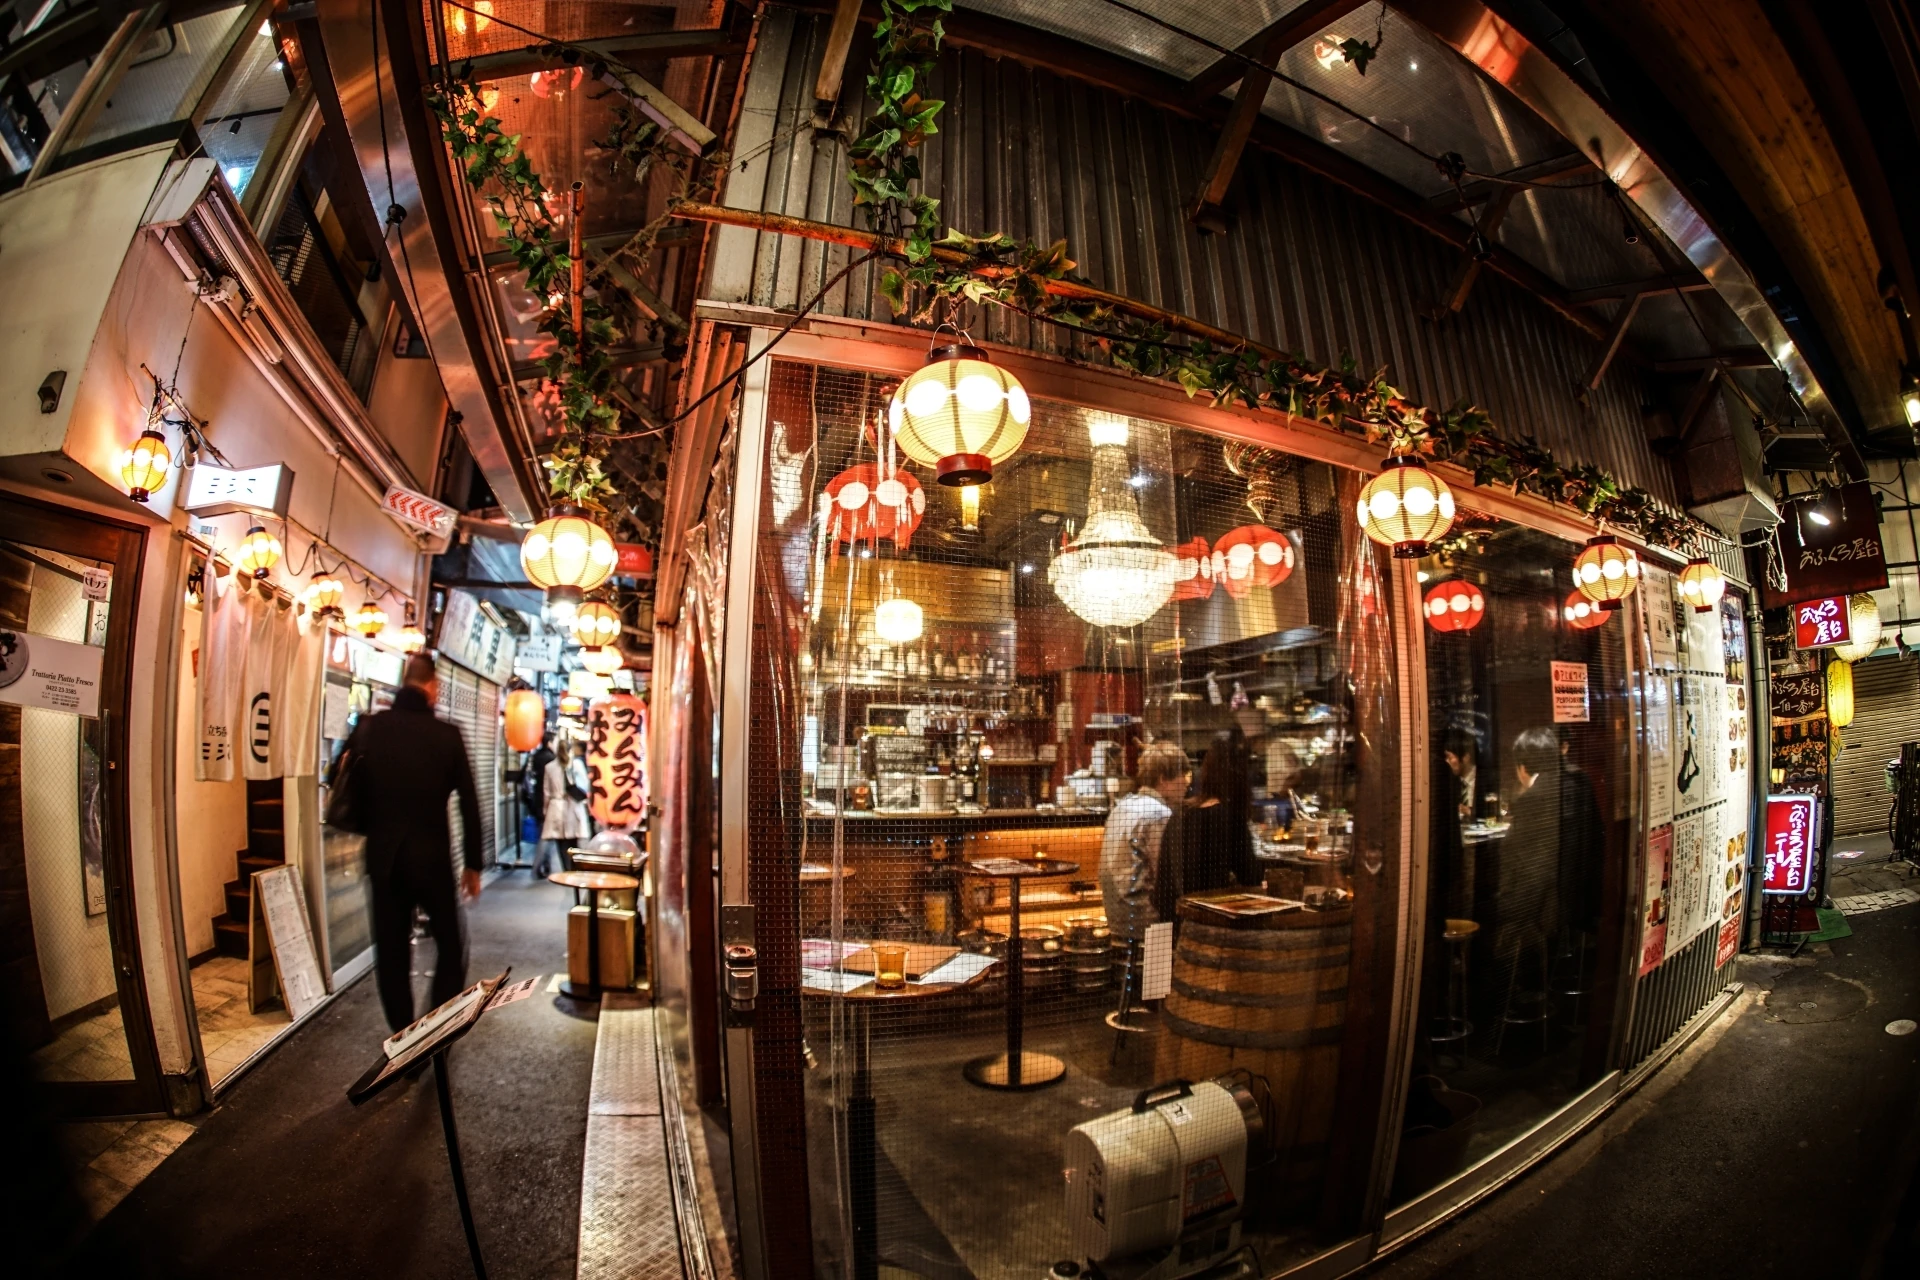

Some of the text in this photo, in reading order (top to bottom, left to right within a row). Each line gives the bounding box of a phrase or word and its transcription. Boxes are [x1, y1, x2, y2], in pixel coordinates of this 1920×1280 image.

[1800, 538, 1879, 569] おふくろ屋台
[1800, 599, 1839, 625] おふくろ
[1813, 619, 1842, 644] 屋台
[31, 669, 94, 687] Trattoria Piatto Fresco
[610, 708, 644, 813] みんみん
[1774, 832, 1788, 864] 一丁目
[1781, 803, 1808, 887] おふくろ屋台
